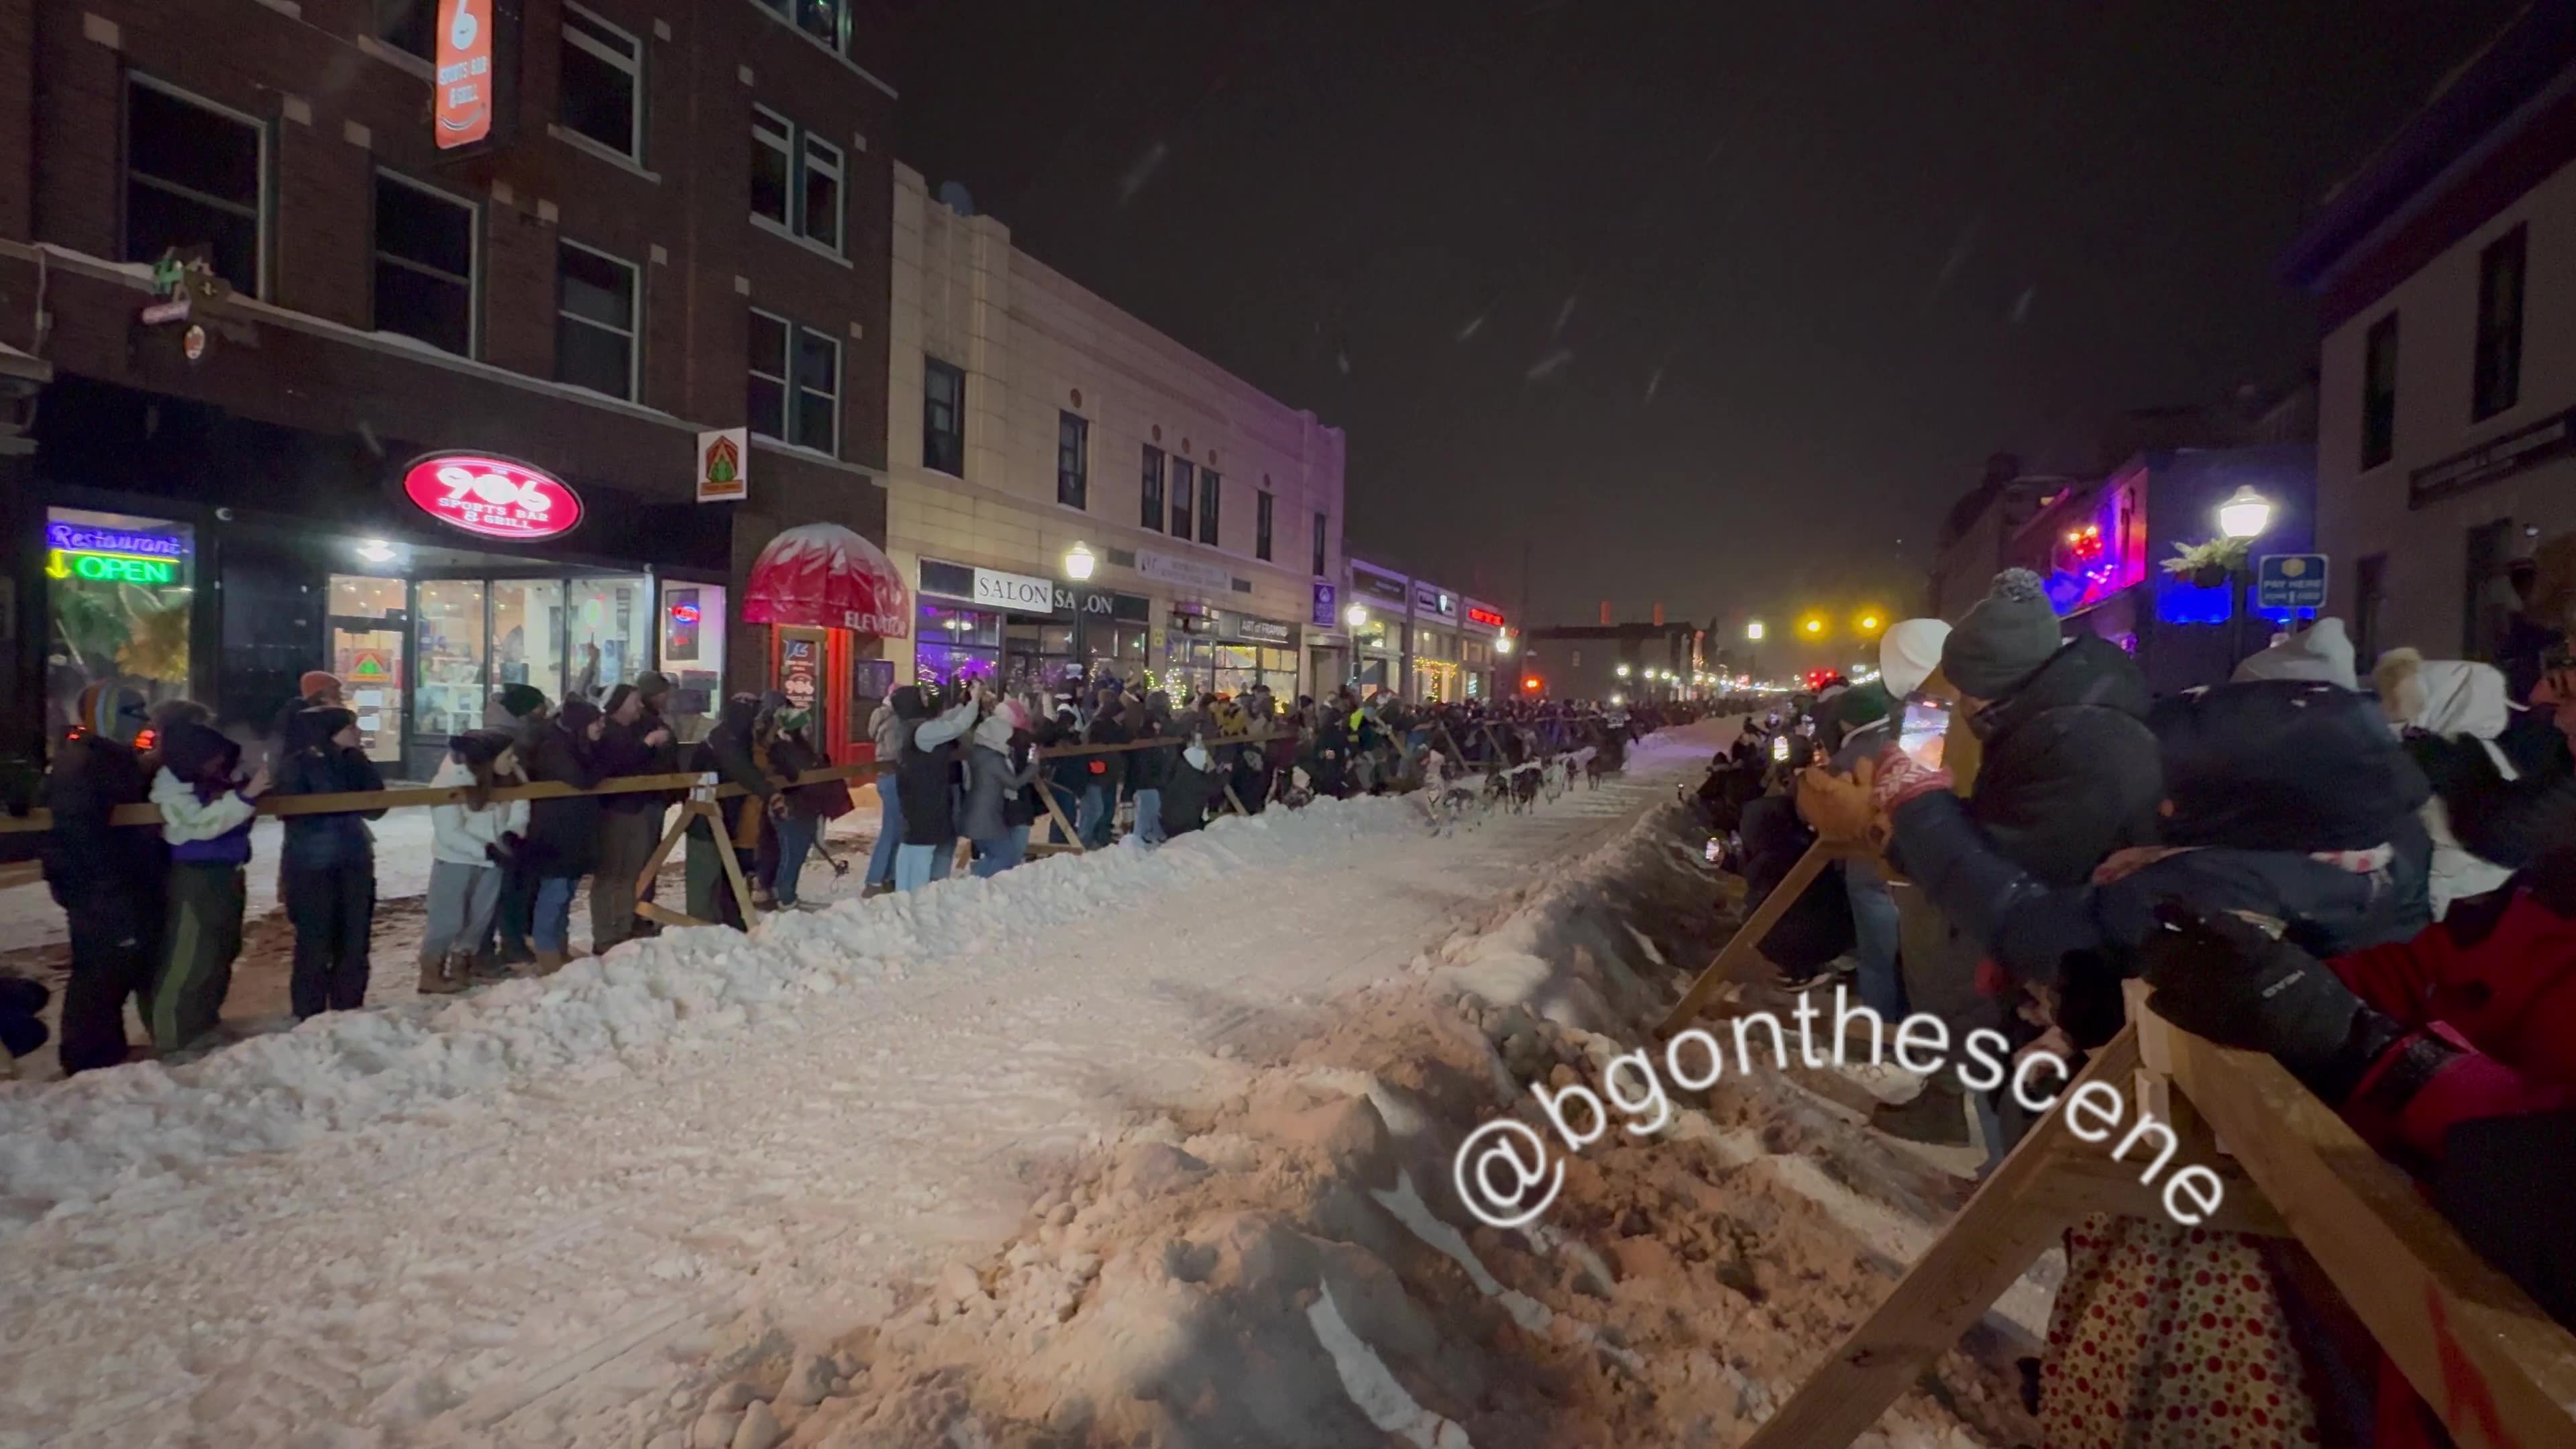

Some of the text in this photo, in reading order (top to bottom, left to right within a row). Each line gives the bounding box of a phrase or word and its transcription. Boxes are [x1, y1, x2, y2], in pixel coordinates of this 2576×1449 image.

[436, 466, 551, 512] 906
[438, 497, 548, 522] SPORTS BAR
[75, 556, 169, 582] OPEN
[979, 577, 1049, 604] SALON
[845, 610, 906, 637] ELEVATOR
